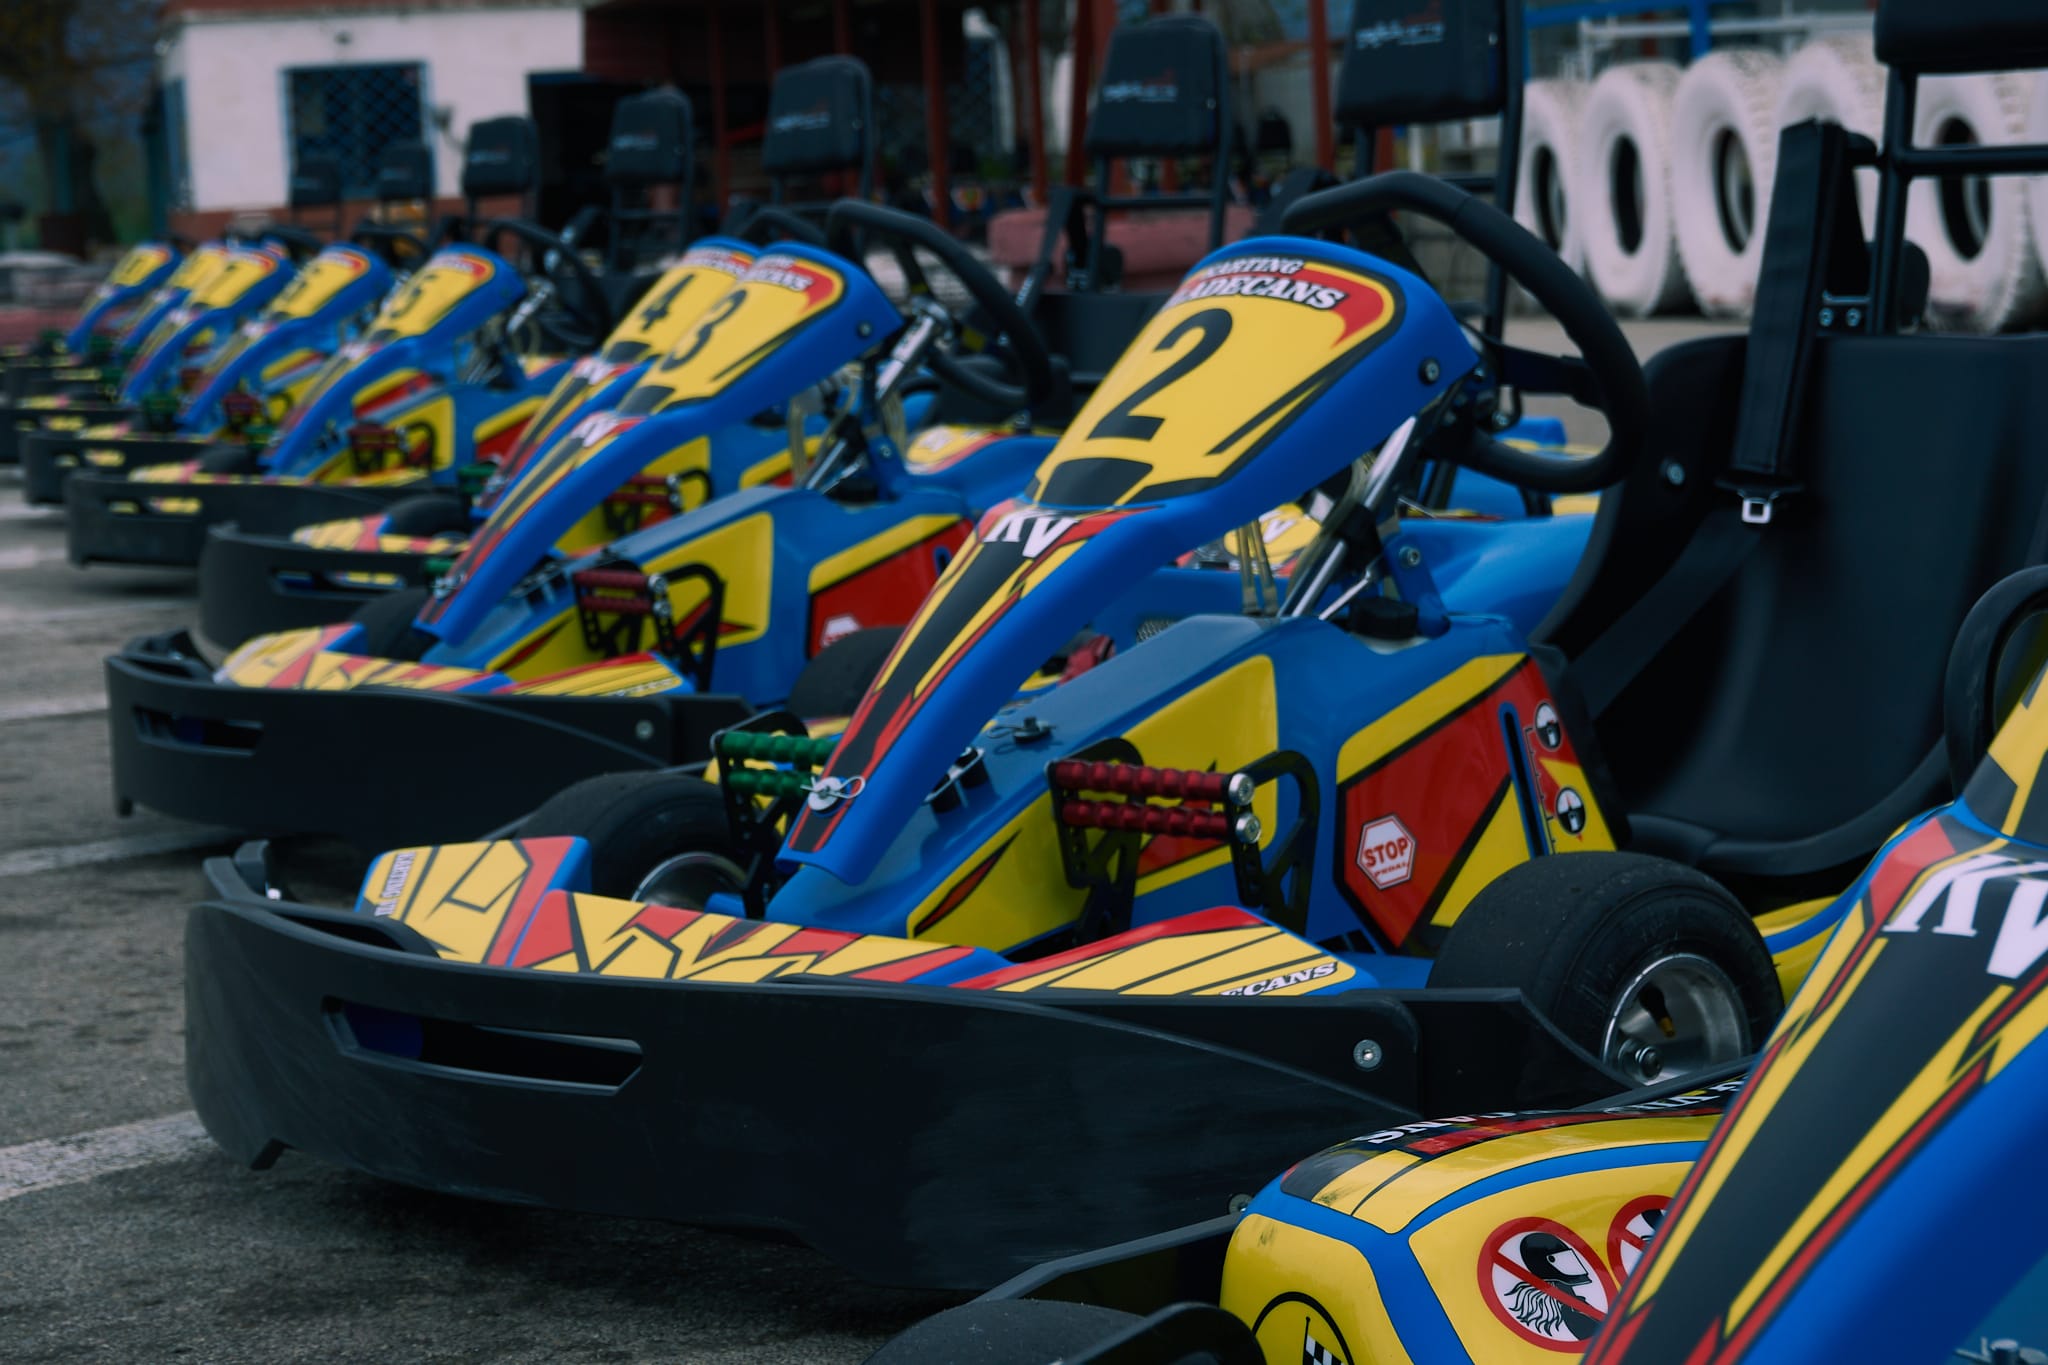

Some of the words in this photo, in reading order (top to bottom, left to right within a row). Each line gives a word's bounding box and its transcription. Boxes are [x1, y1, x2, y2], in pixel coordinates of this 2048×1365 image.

[641, 273, 696, 331] 4
[660, 289, 748, 371] 3
[1086, 308, 1233, 441] 2
[1364, 837, 1408, 867] STOP
